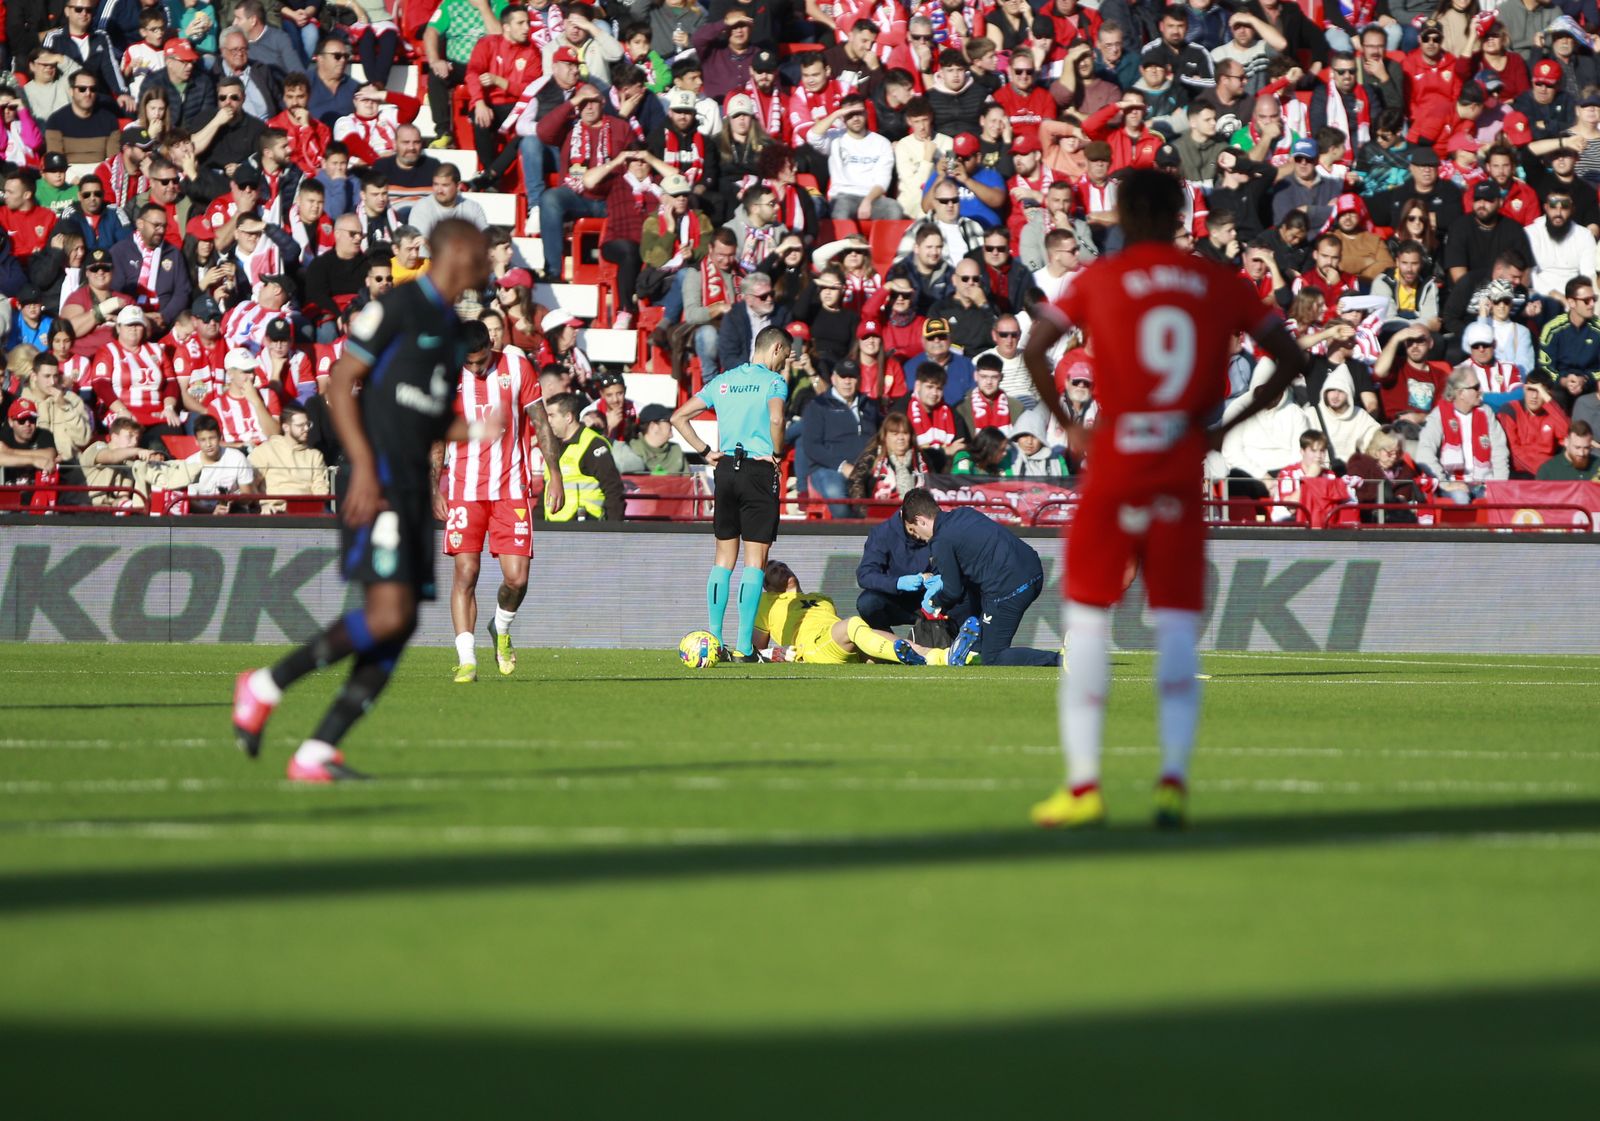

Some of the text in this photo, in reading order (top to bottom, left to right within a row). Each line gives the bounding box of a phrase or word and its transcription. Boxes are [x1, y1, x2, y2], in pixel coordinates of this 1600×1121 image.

[1136, 304, 1198, 407] 9
[446, 506, 468, 530] 23
[1, 543, 364, 643] KOK
